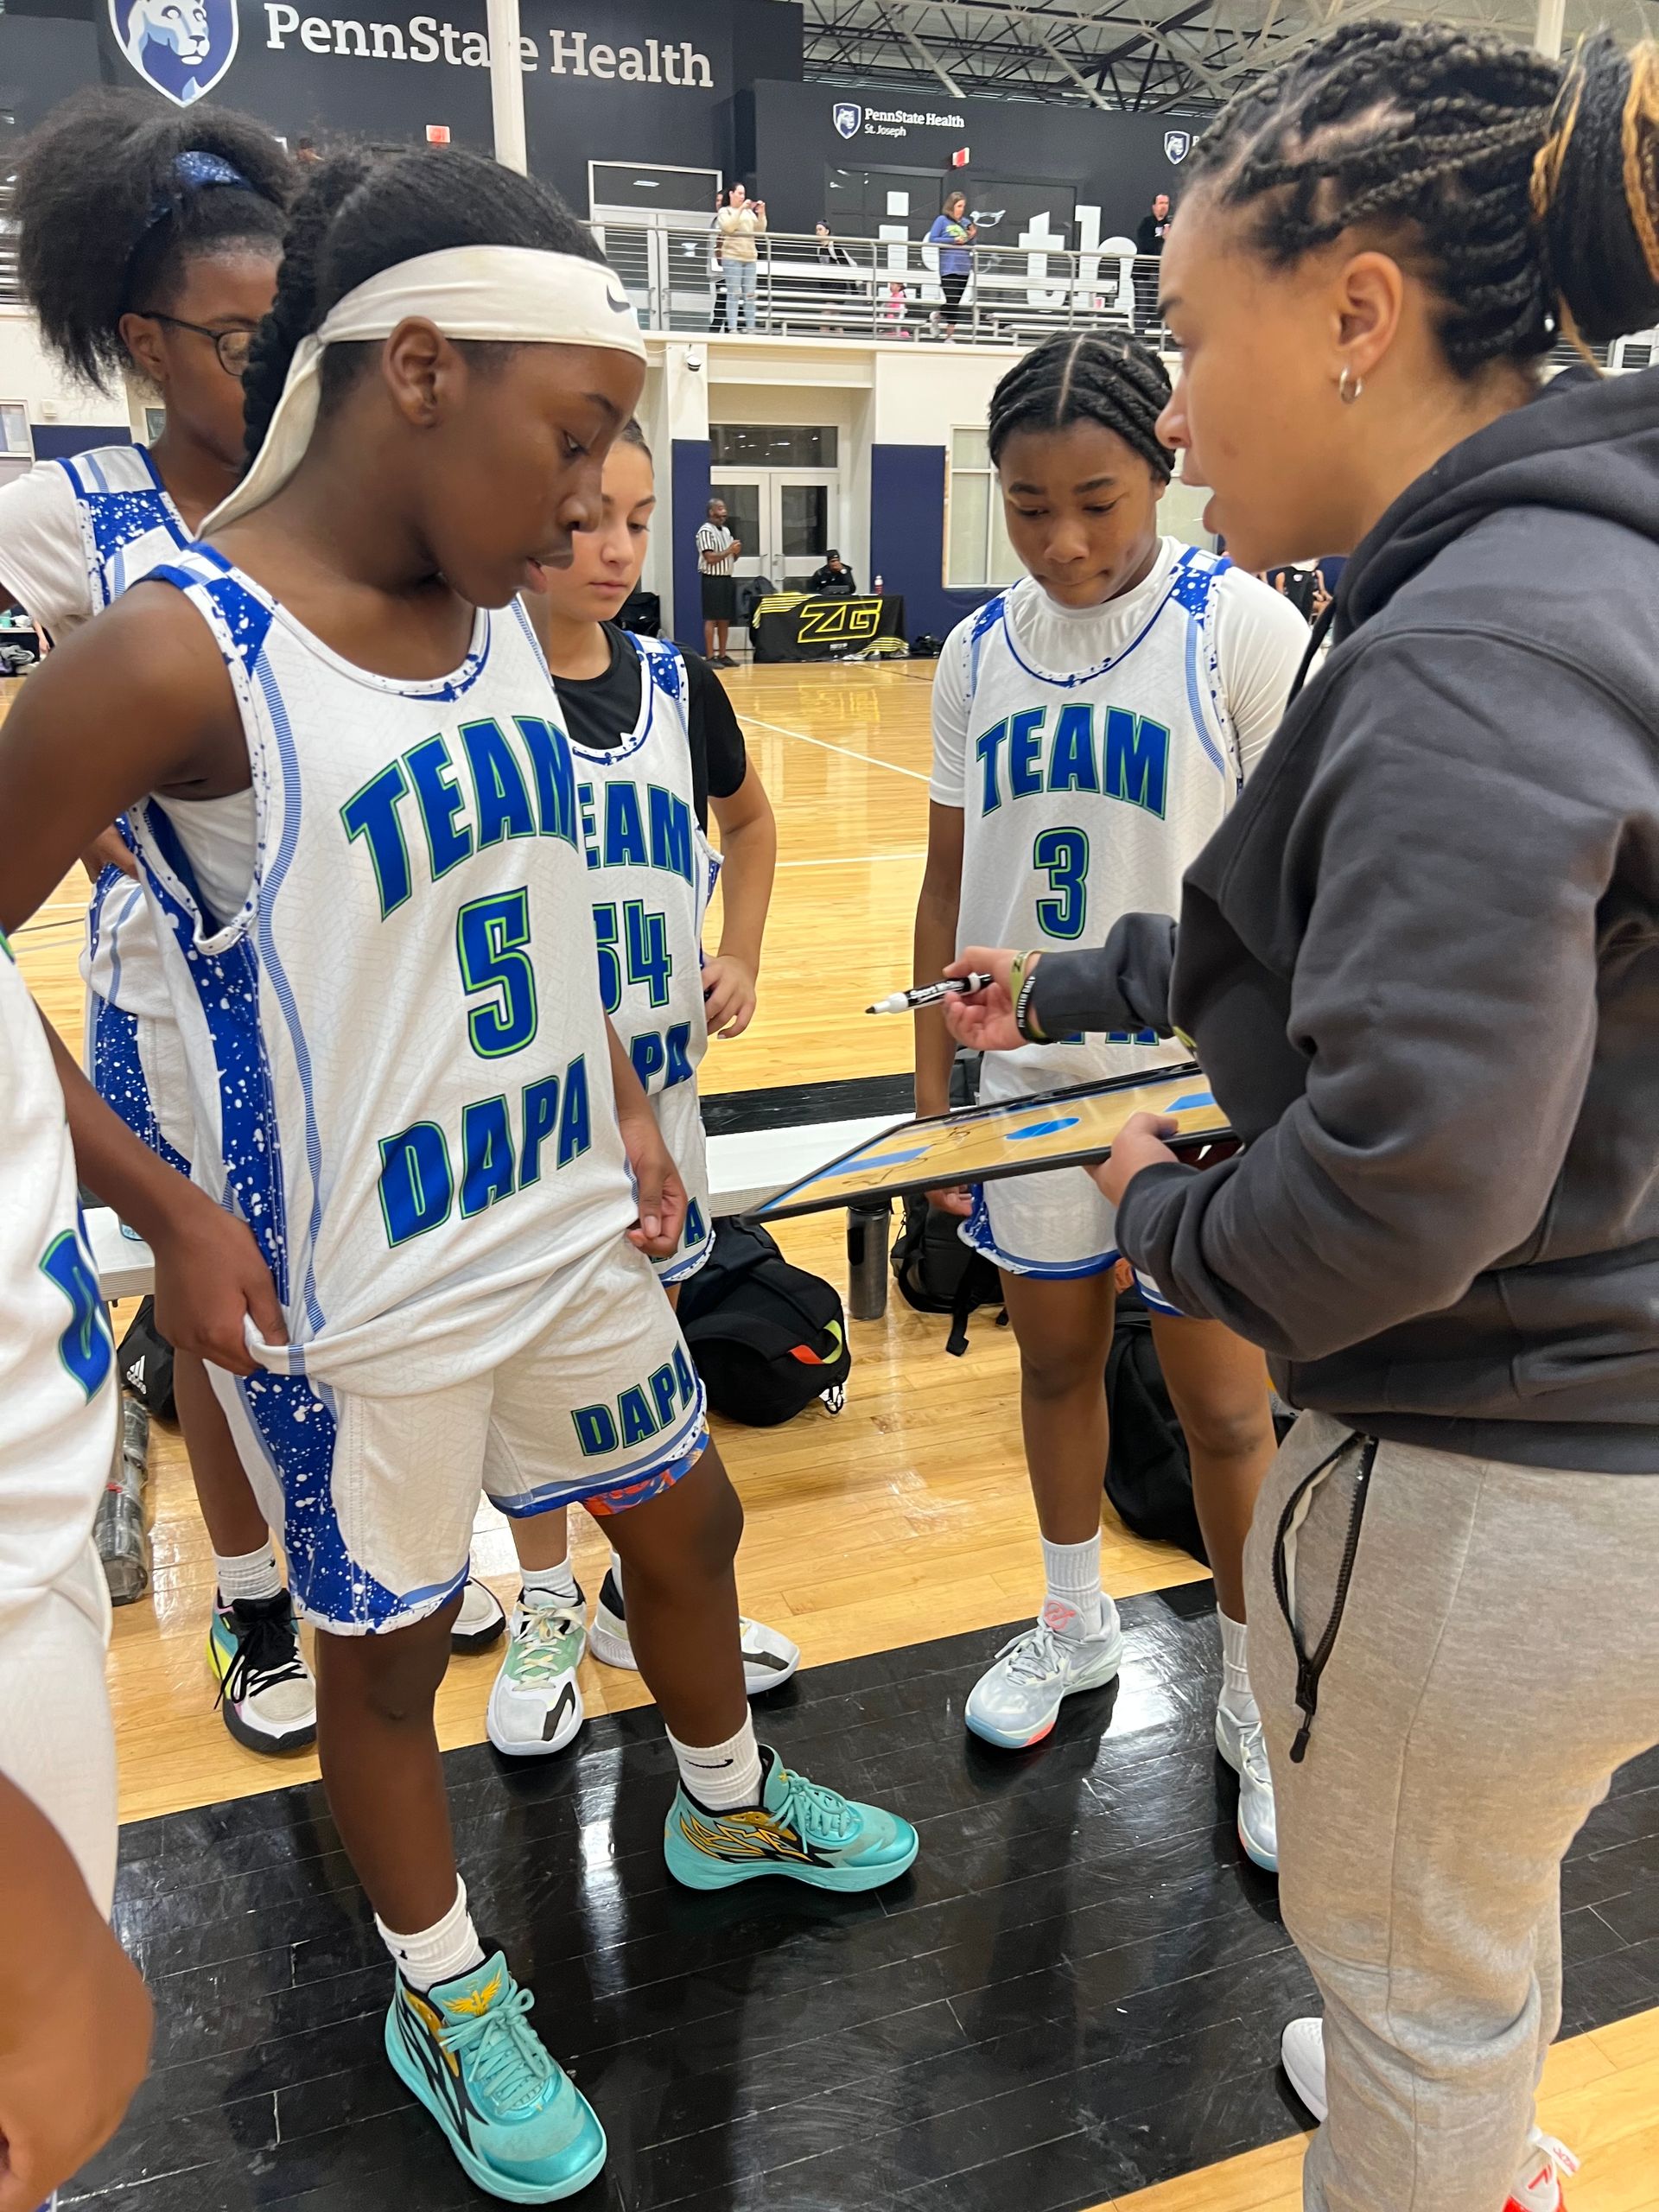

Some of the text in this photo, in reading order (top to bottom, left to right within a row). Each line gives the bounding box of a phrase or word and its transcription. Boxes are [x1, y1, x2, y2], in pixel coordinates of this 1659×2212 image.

[264, 3, 714, 87] PennStae Health
[864, 108, 966, 128] PennState Health
[876, 124, 906, 137] Joseph
[798, 599, 883, 643] ZG
[339, 715, 579, 922] TEAM
[976, 702, 1171, 820] TEAM
[577, 781, 694, 887] EAM
[1033, 826, 1089, 940] 3
[457, 887, 537, 1059] 5
[592, 899, 672, 1015] 54
[378, 1052, 591, 1249] DAPA
[571, 1339, 696, 1457] DAPA
